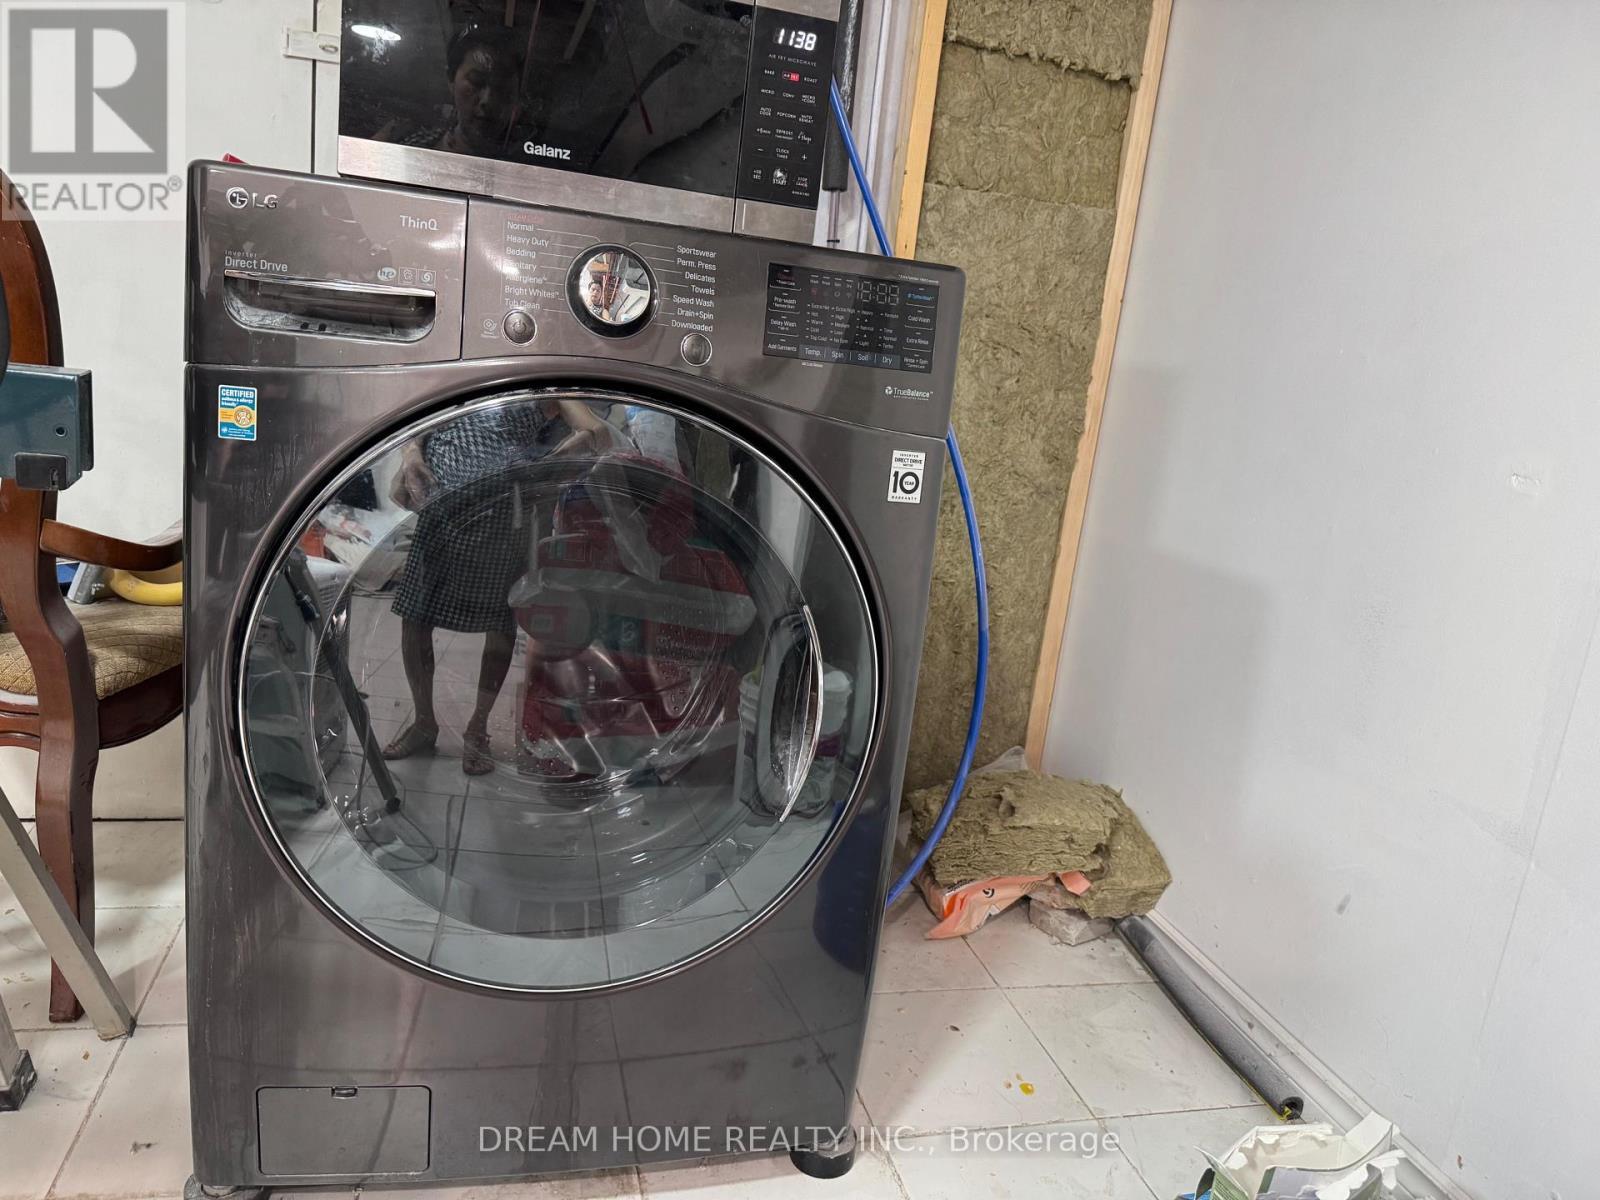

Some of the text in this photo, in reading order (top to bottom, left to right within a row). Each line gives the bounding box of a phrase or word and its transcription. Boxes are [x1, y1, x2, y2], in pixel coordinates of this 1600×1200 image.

[778, 28, 817, 51] 1138
[523, 141, 571, 160] Galanz
[252, 192, 279, 209] LG
[400, 214, 440, 231] ThinQ
[507, 221, 534, 231] Normal
[506, 234, 549, 248] Heavy Duty
[506, 246, 536, 259] Bedding
[676, 245, 717, 257] Sportswear
[225, 256, 288, 272] Direct Drive
[677, 258, 716, 271] Perm. Press
[685, 271, 716, 283] Delicates
[504, 285, 527, 296] Bright
[691, 284, 715, 295] Towels
[672, 294, 714, 307] Speed Wash
[671, 320, 713, 332] Downloaded
[831, 350, 844, 359] Spin
[882, 356, 893, 365] Dry
[221, 389, 254, 398] CERTIFIED
[892, 470, 920, 494] 10
